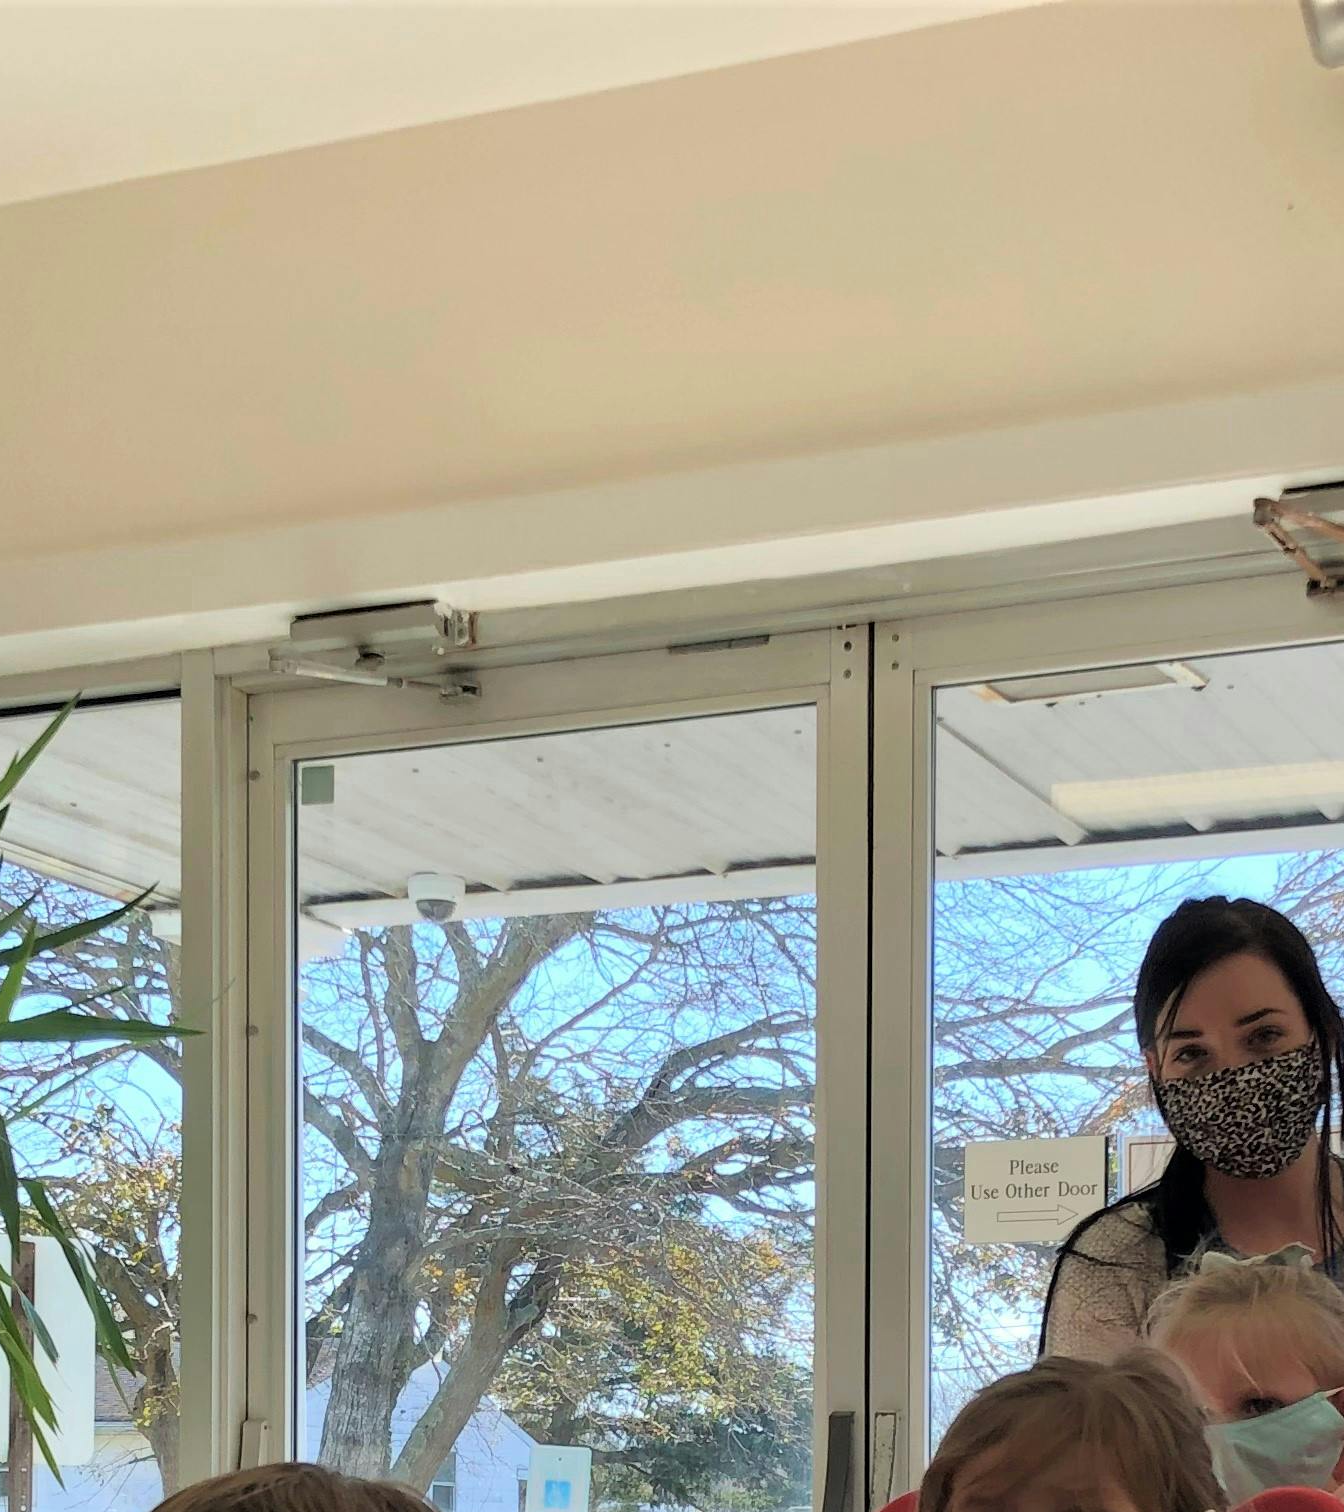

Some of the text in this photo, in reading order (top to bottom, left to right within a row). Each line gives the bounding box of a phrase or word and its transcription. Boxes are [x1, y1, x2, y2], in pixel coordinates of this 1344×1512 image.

[1009, 1159, 1060, 1175] Please
[971, 1181, 1098, 1200] Use Other Door
